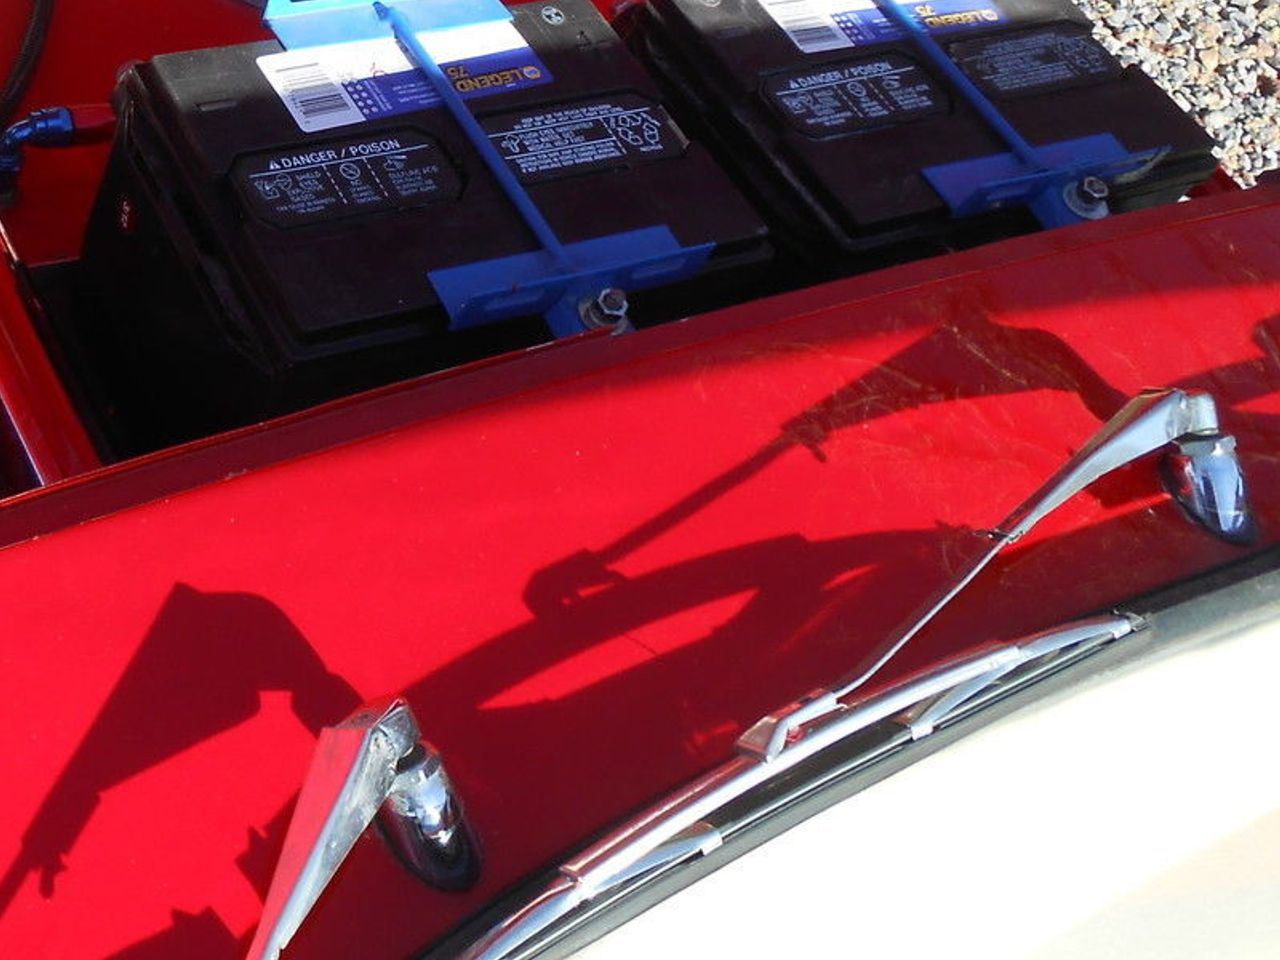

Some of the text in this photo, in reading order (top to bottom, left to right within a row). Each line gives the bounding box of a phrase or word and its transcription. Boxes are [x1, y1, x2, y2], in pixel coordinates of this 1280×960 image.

[446, 64, 468, 79] 75
[454, 68, 524, 92] LEGEND
[798, 70, 844, 87] DANGER
[280, 149, 338, 169] DANGER
[349, 138, 402, 157] POISON
